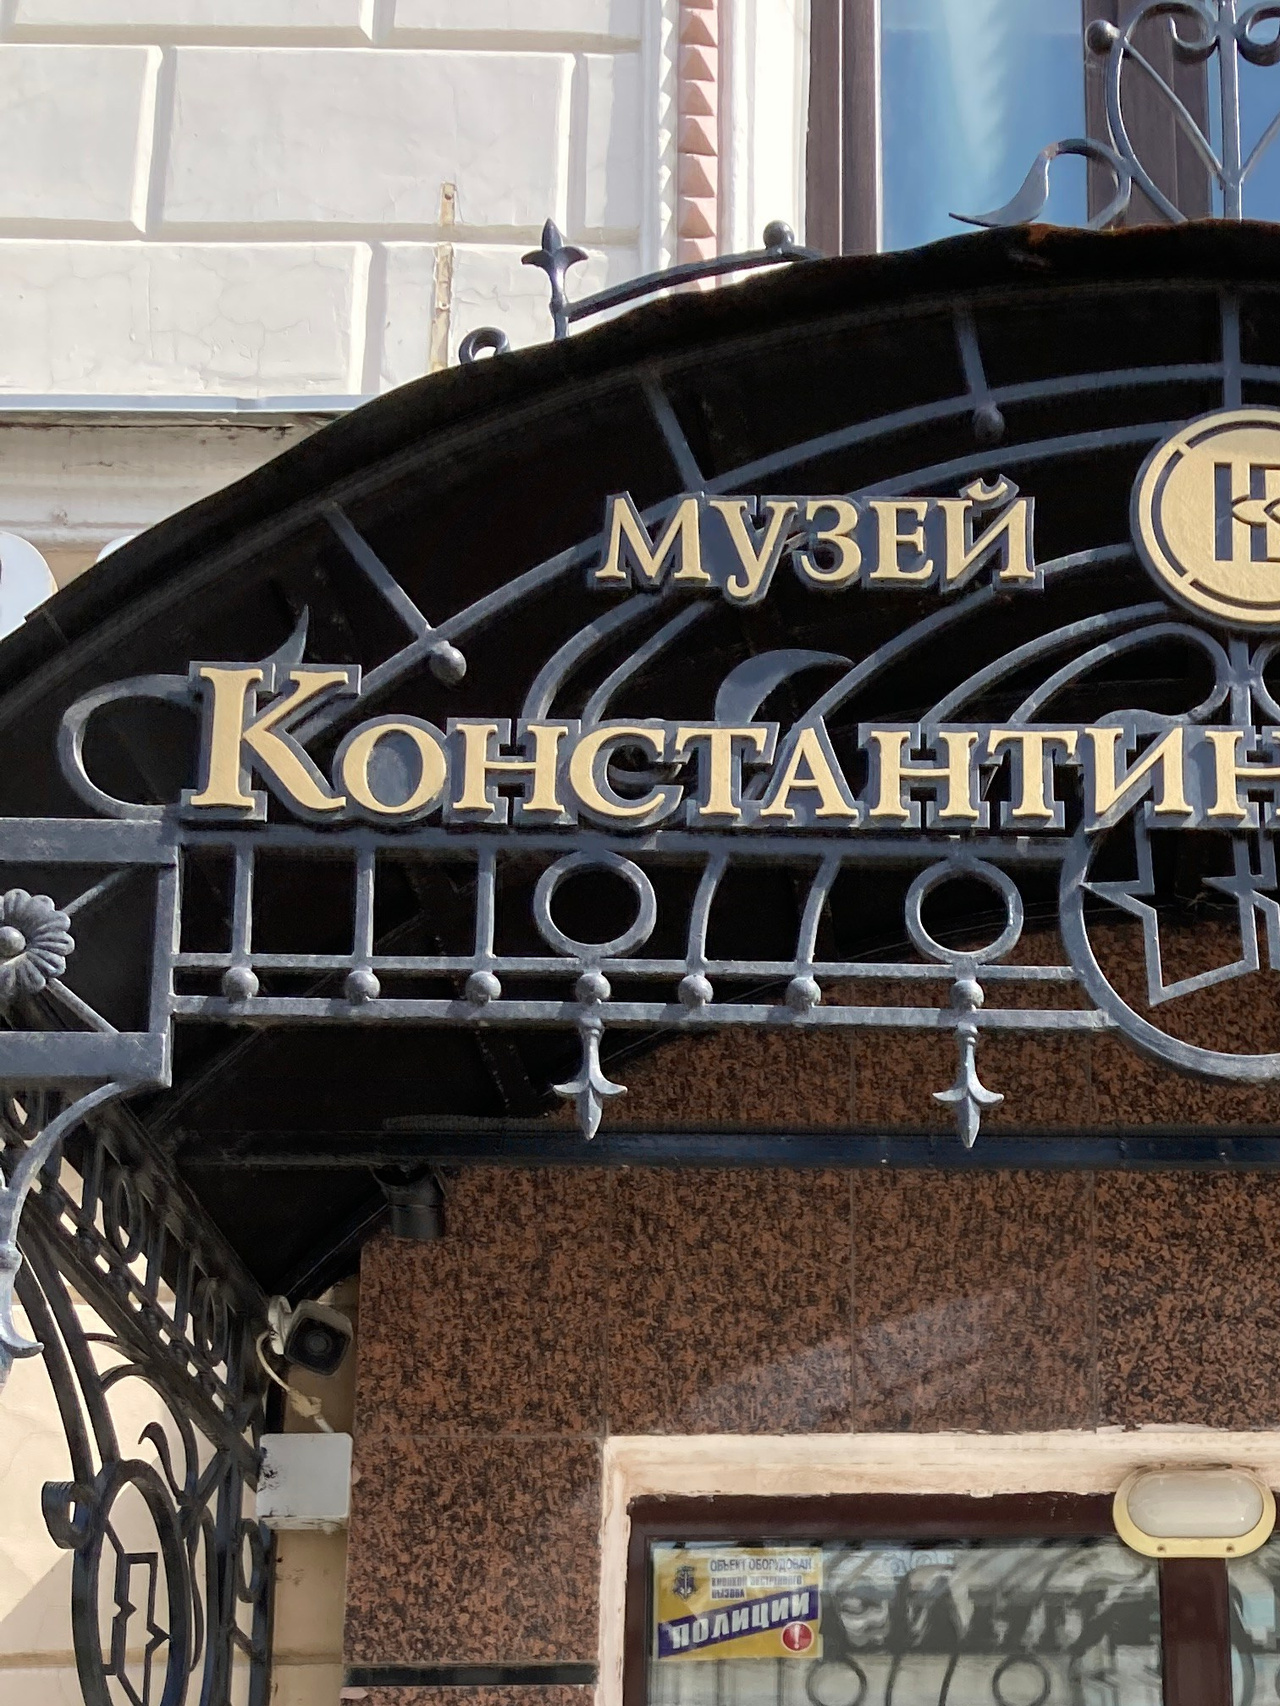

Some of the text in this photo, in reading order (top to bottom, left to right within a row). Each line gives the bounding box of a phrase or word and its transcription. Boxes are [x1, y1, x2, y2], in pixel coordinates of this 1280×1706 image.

[594, 478, 1039, 600] МУЗЕЙ
[711, 1558, 812, 1572] ОБЪЕКТ ОБОРУДОВАН
[670, 1592, 810, 1649] ПОЛИЦИИ
